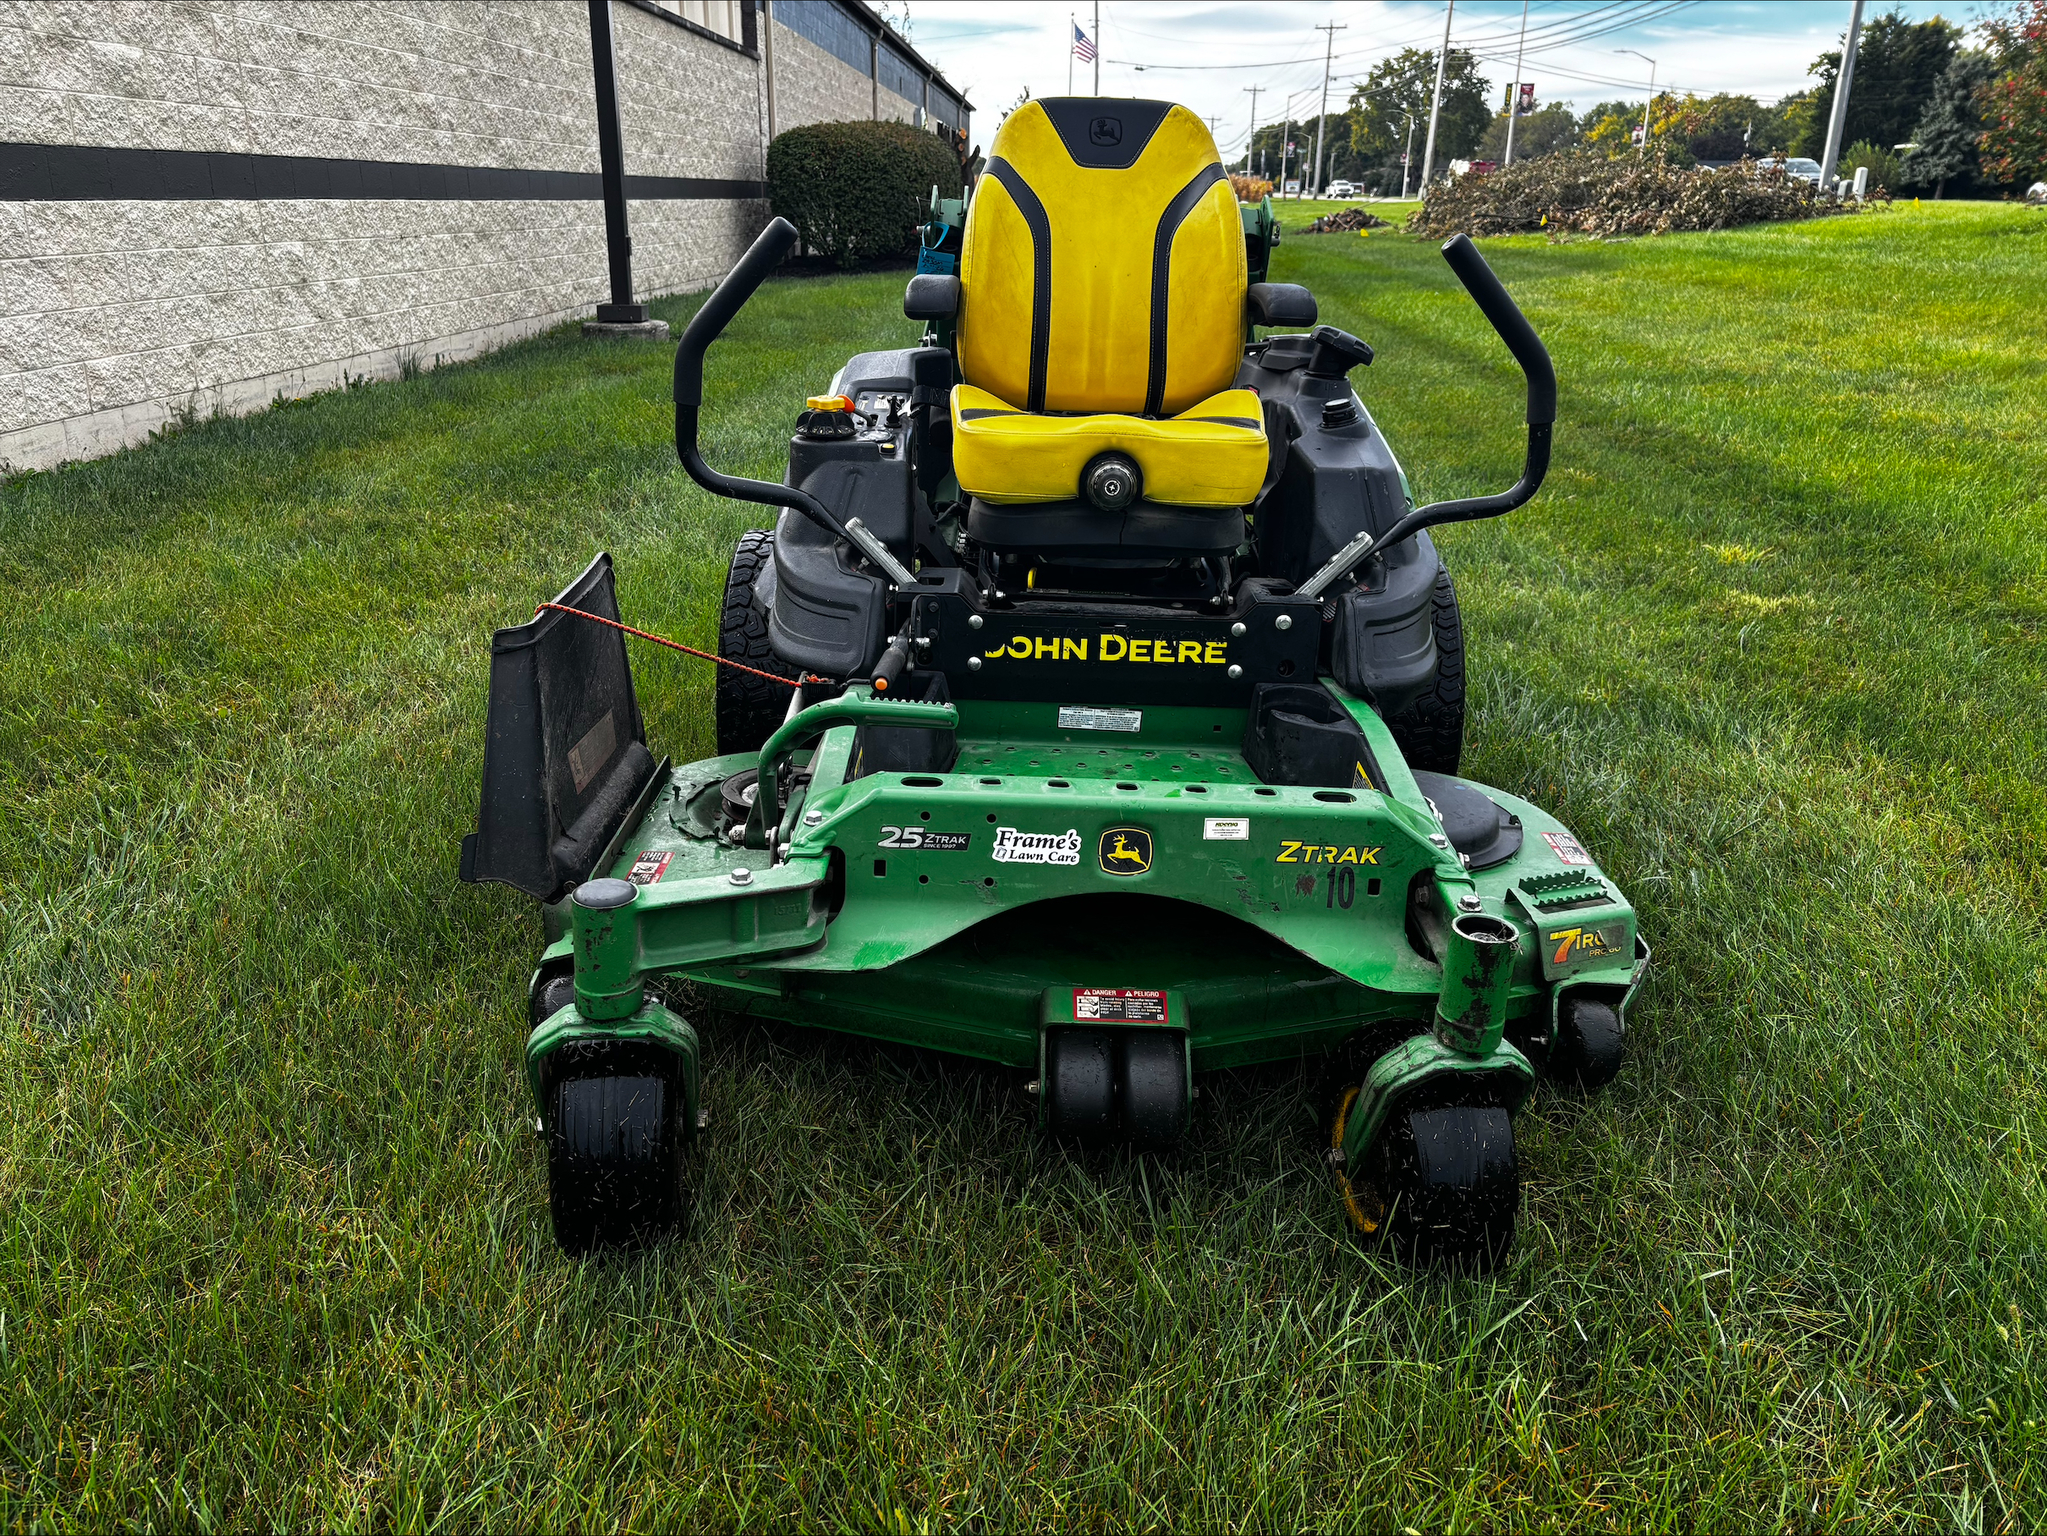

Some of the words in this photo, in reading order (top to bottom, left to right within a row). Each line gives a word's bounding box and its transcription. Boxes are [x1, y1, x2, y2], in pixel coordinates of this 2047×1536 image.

[985, 635, 1088, 661] JOHN
[1099, 634, 1228, 664] DEERE
[877, 826, 925, 849] 25
[924, 833, 967, 845] ZTRAK
[996, 830, 1079, 851] Frame's
[1008, 849, 1044, 861] Lawn
[1048, 851, 1077, 862] Care
[1275, 840, 1383, 865] ZTRAK
[1326, 866, 1355, 910] 10
[1550, 927, 1582, 964] 7
[1133, 990, 1160, 998] PELIGRO
